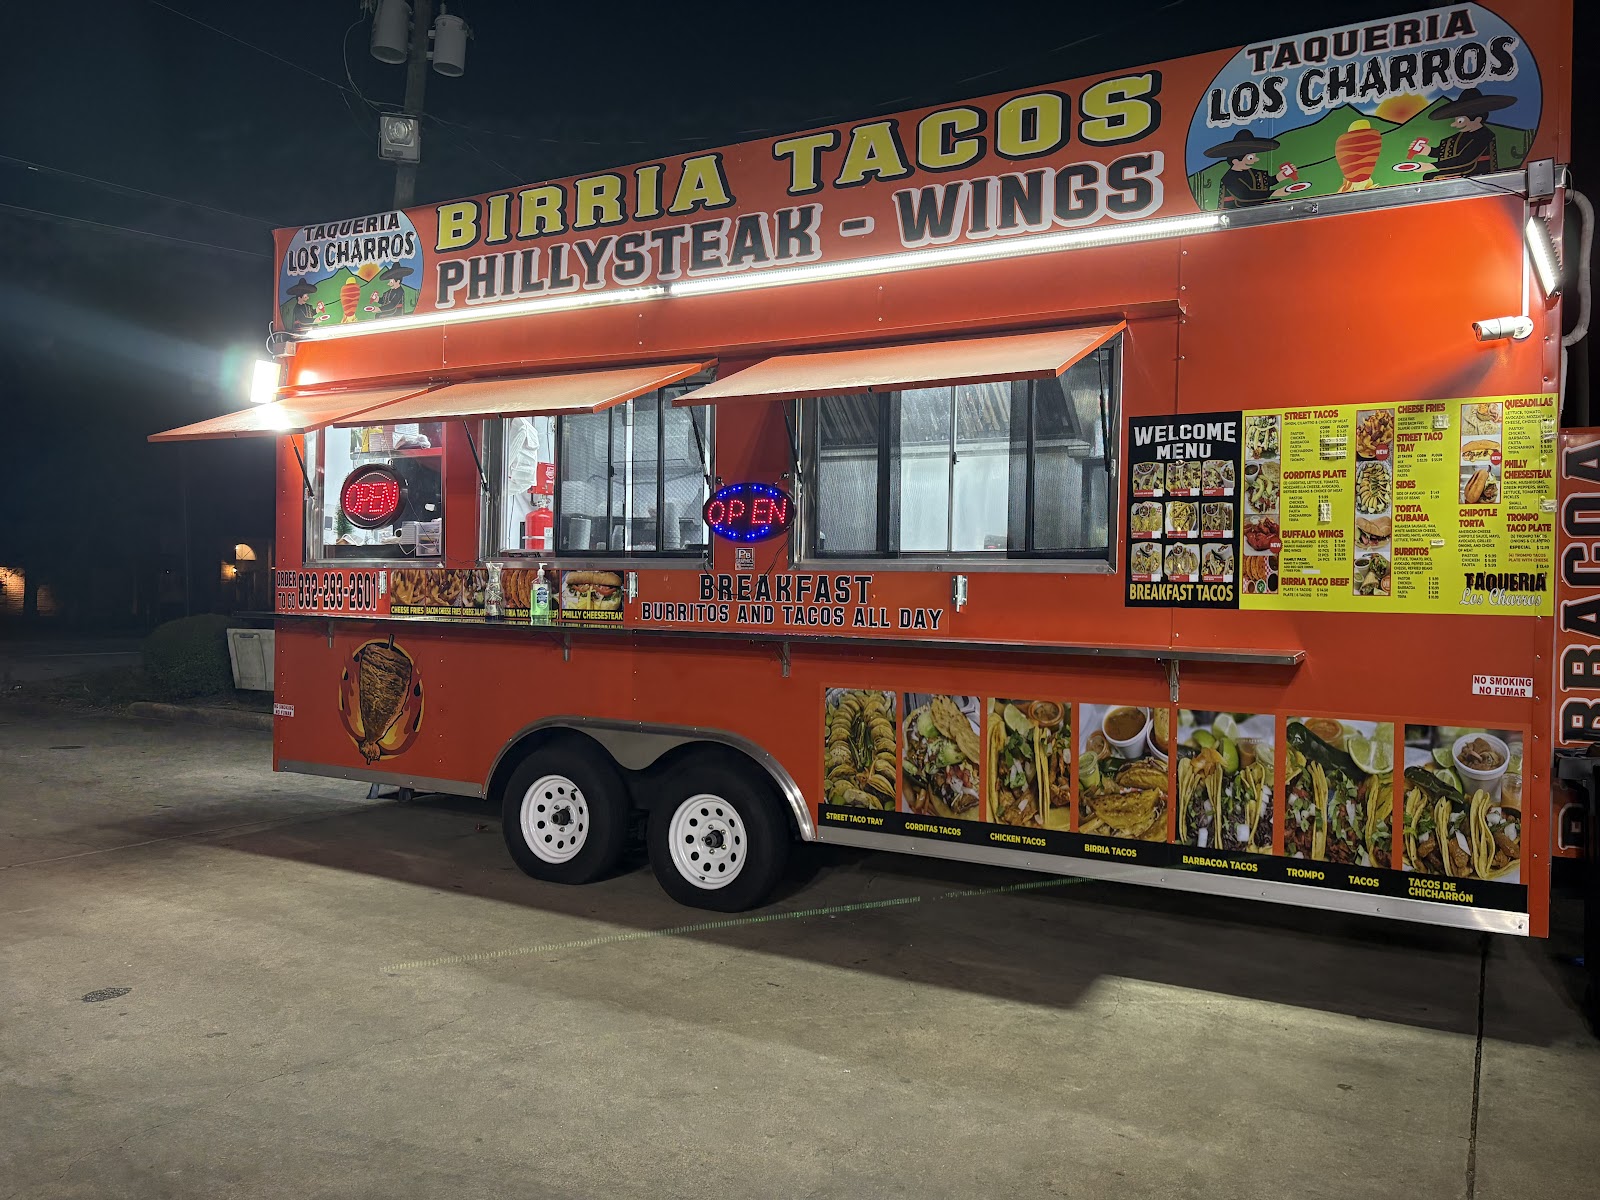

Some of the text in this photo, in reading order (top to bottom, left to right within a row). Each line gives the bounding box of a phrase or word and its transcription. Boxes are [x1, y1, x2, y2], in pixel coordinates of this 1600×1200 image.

[1247, 9, 1476, 73] TAQUERIA
[1210, 35, 1517, 122] LOS CHARROS
[433, 69, 1163, 253] BIRRIA TACOS
[304, 212, 400, 241] TAQUERIA
[435, 203, 822, 309] PHILLYSTEAK
[895, 151, 1166, 248] WINGS
[288, 232, 415, 272] LOS CHARROS
[1398, 403, 1445, 414] CHEESE FRIES
[1505, 398, 1553, 410] QUESADILLAS
[1284, 410, 1338, 420] STREET TACOS
[1134, 422, 1237, 447] WELCOME
[1397, 432, 1443, 442] STREET TACO
[1156, 443, 1212, 460] MENU
[1397, 444, 1415, 452] TRAY
[1505, 460, 1527, 468] PHILLY
[1283, 470, 1346, 479] GORDITAS PLATE
[1504, 470, 1552, 479] CHEESESTEAK
[1396, 480, 1416, 489] SIDES
[345, 481, 398, 512] OPEN
[707, 498, 788, 525] OPEN
[1459, 509, 1497, 517] CHIPOTLE
[1282, 530, 1344, 538] BUFFALO WINGS
[1507, 524, 1526, 532] TACO
[1394, 547, 1429, 556] BURRITOS
[699, 574, 872, 604] BREAKFAST
[1330, 578, 1349, 586] BEEF
[1464, 572, 1547, 593] TAQUERIA
[277, 570, 377, 611] ORDER 832-293-2601
[1129, 584, 1233, 601] BREAKFAST TACOS
[1460, 588, 1484, 605] Los
[1488, 588, 1542, 606] Charros
[287, 592, 295, 610] GO
[583, 611, 623, 620] CHEESESTEAK
[641, 602, 943, 630] BURRITOS AND TACOS ALL DAY
[1474, 676, 1532, 686] NO SMOKING
[1495, 687, 1526, 696] FUMAR
[826, 812, 884, 826] STREET TACO TRAY
[905, 822, 961, 836] GORDITAS TACOS
[990, 832, 1046, 847] CHICKEN TACOS
[1084, 844, 1137, 858] BIRRIA TACOS
[1182, 855, 1258, 872] BARBACOA TACOS
[1286, 868, 1379, 888] TROMPO TACOS
[1408, 878, 1456, 891] TACOS DE
[1408, 886, 1474, 903] CHICHARRÓN
